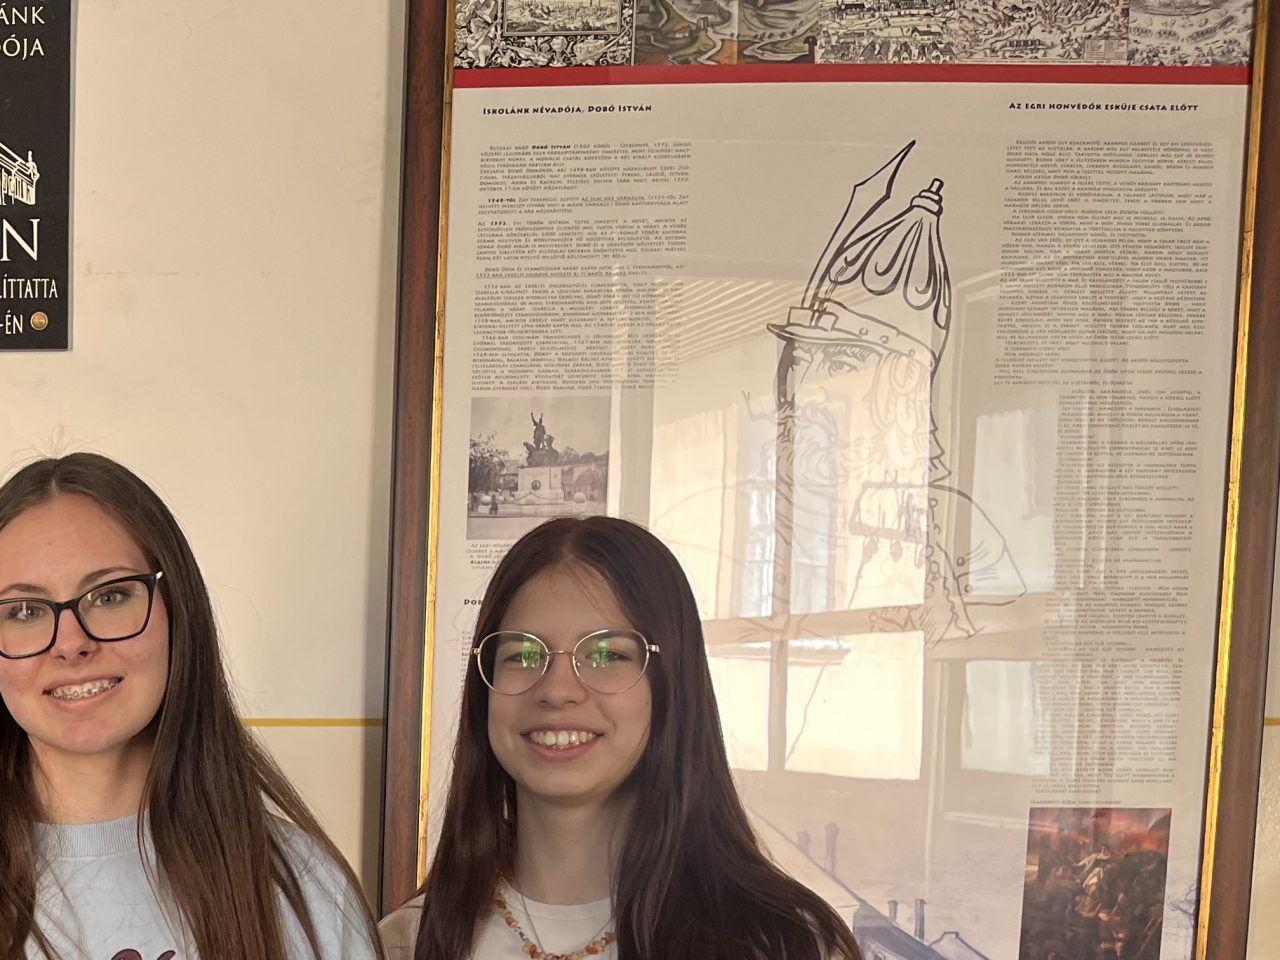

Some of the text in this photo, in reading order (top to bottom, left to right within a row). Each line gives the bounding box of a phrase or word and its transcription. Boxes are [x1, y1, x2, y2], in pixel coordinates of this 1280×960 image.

[483, 107, 529, 115] ISKOLÁNK
[533, 106, 584, 114] NÉVADÓJA,
[588, 105, 615, 113] DOBÓ
[1105, 103, 1136, 111] ESKÜJE
